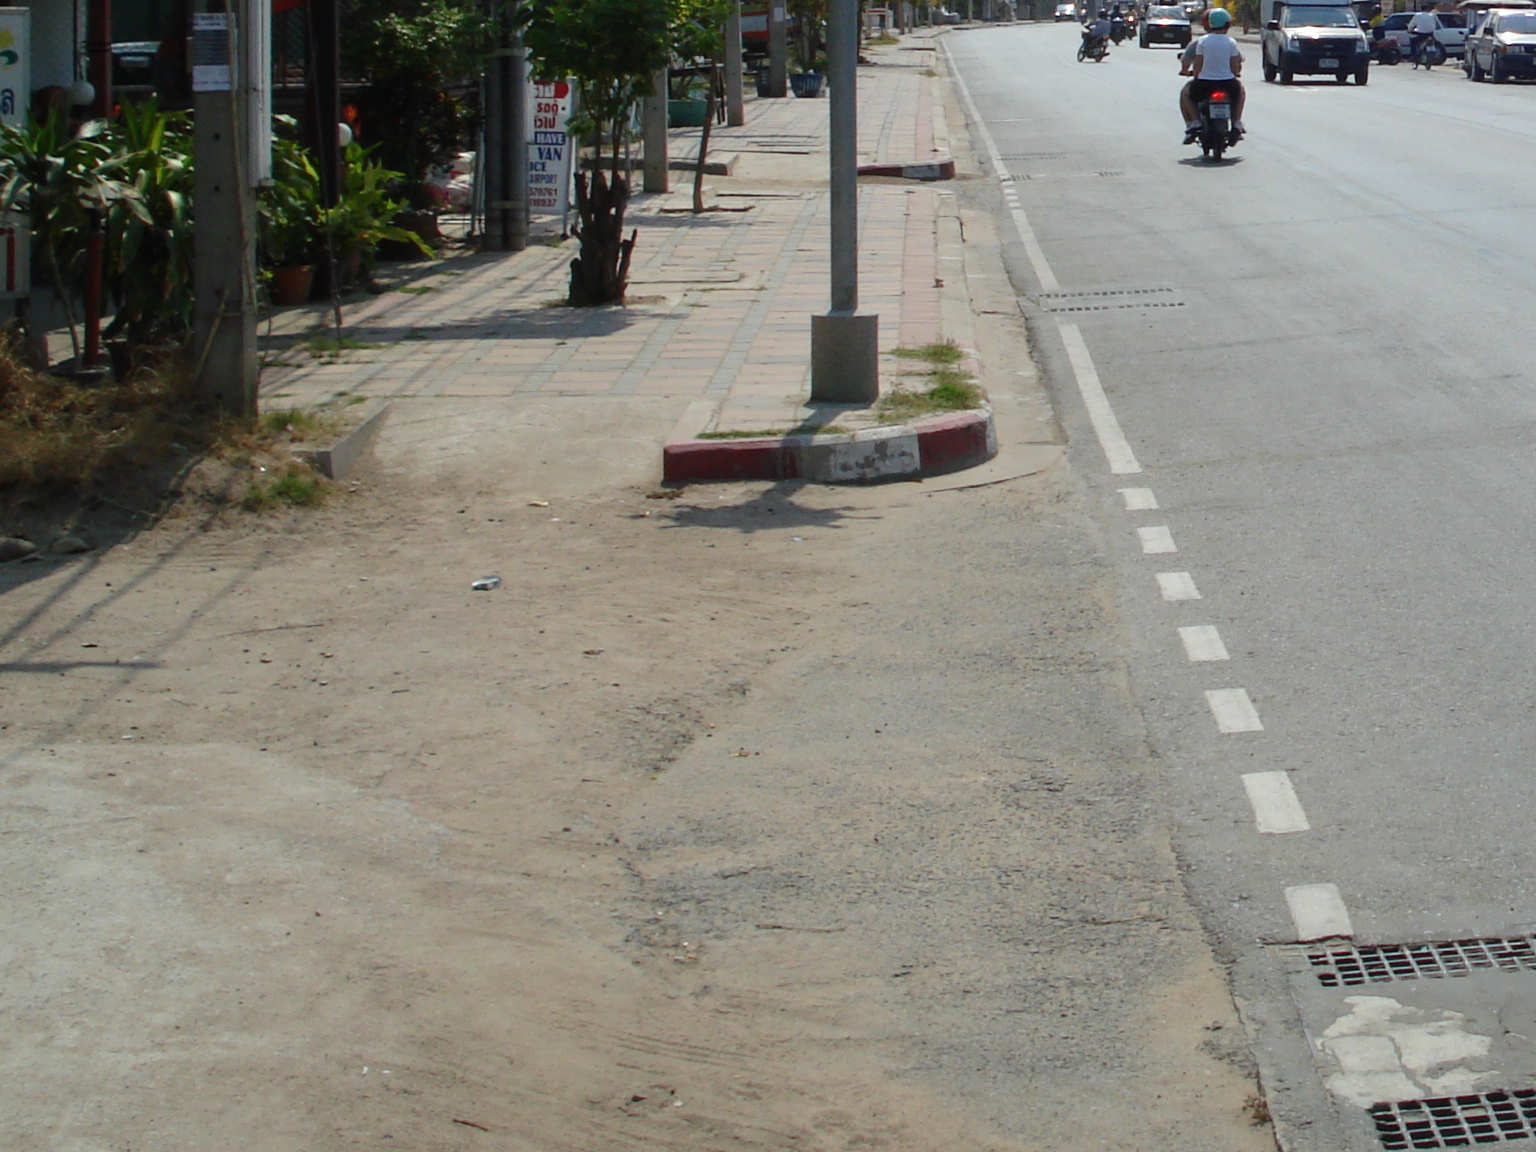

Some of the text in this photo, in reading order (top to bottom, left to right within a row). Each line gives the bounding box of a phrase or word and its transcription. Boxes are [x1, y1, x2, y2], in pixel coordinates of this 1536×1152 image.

[536, 133, 564, 144] HAVE
[537, 147, 562, 161] VAN
[529, 174, 558, 184] AIRPORT
